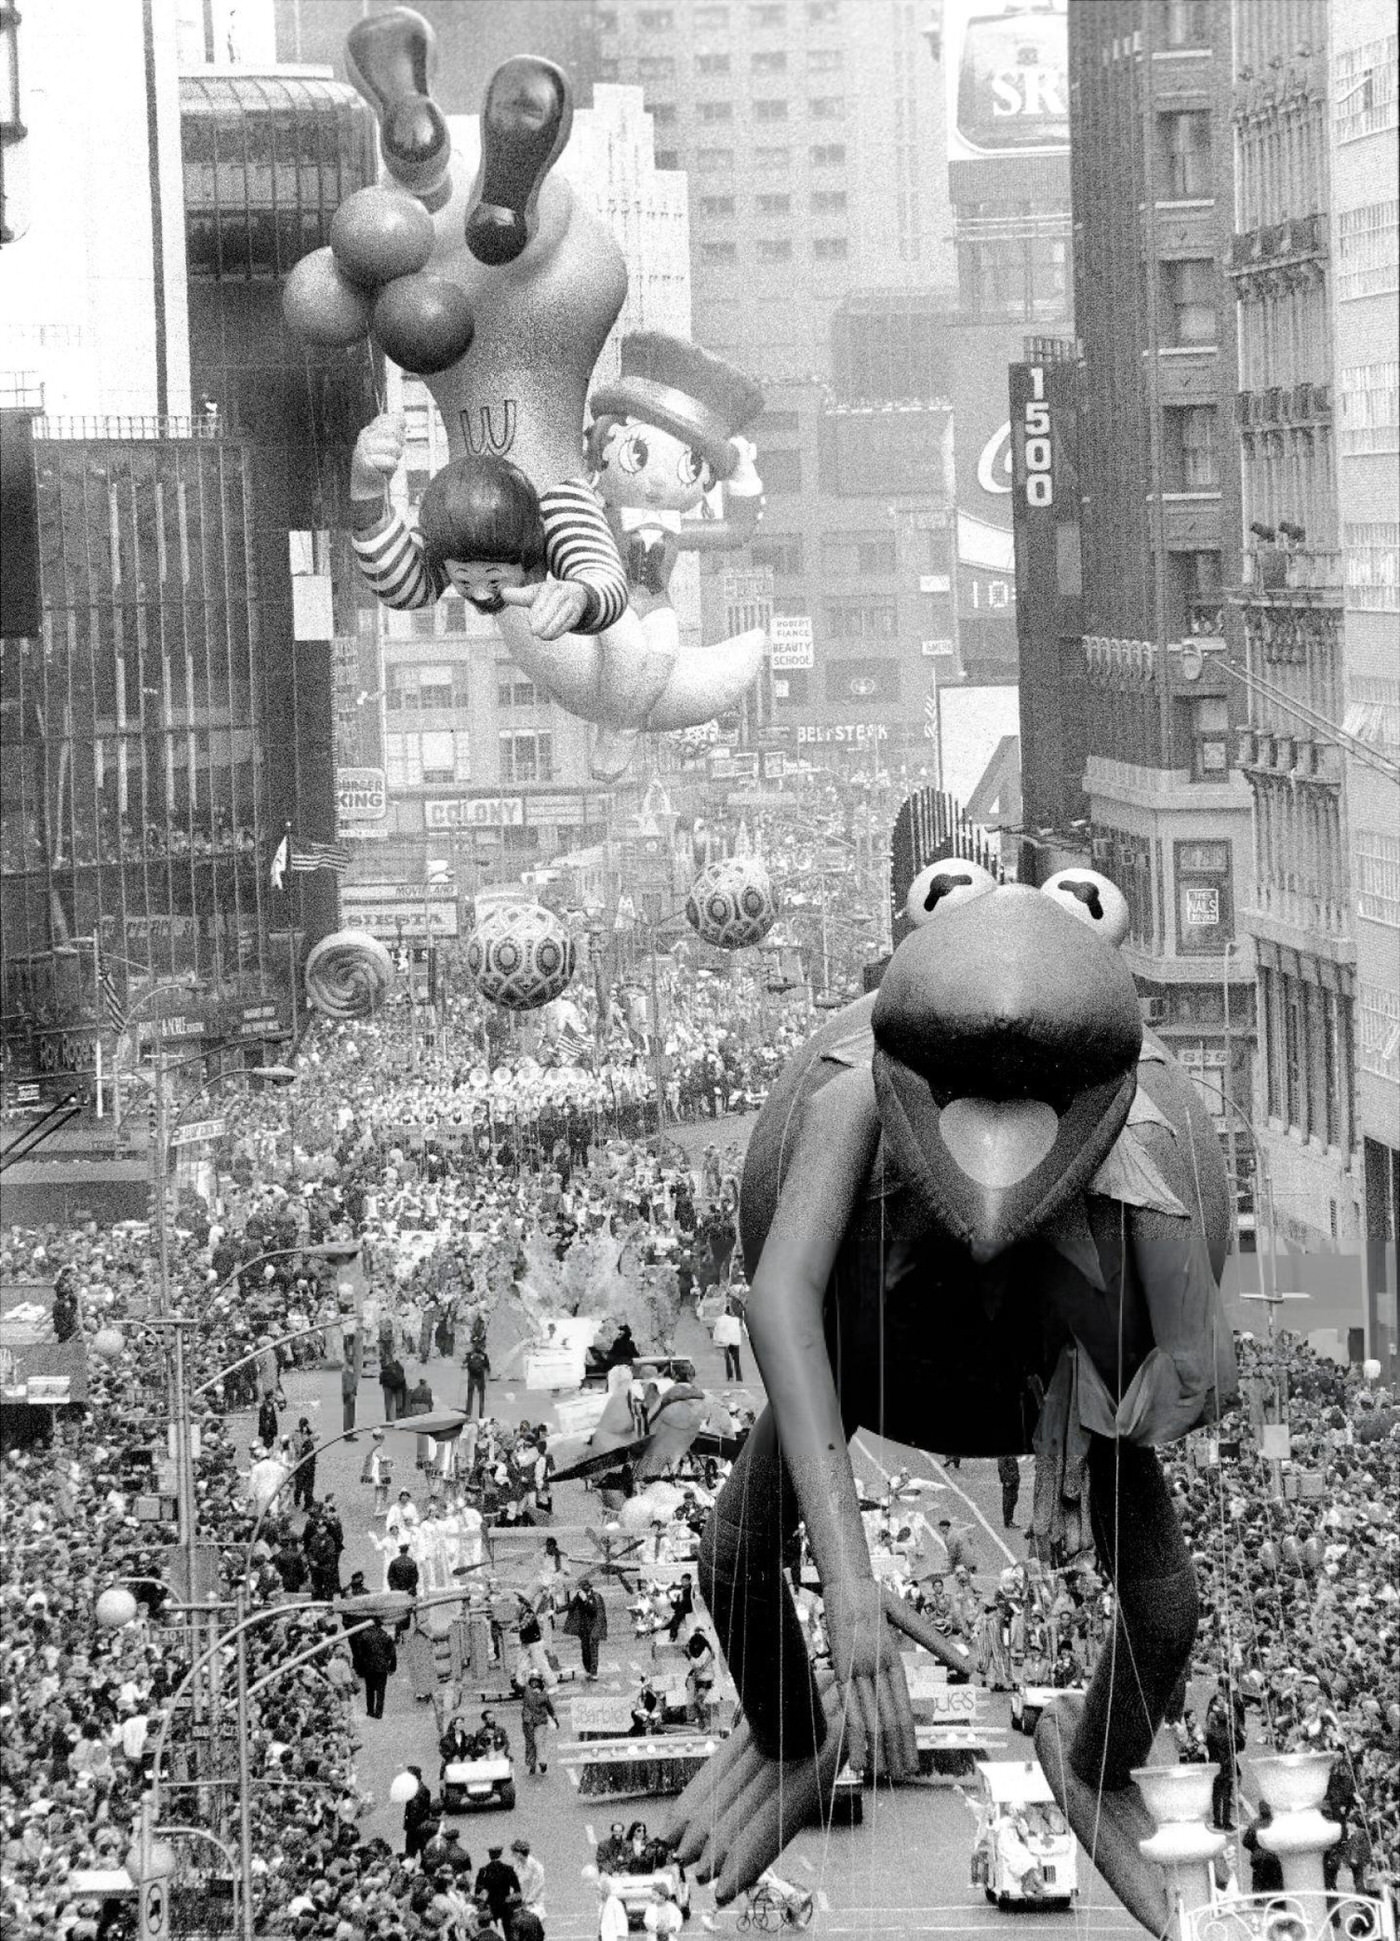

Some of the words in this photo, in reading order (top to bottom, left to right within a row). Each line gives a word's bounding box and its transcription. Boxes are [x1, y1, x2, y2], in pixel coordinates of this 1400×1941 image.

[1024, 367, 1053, 506] 1500
[773, 642, 812, 654] BEAUTY
[774, 655, 812, 666] SCHOOL
[431, 801, 518, 825] COLONY
